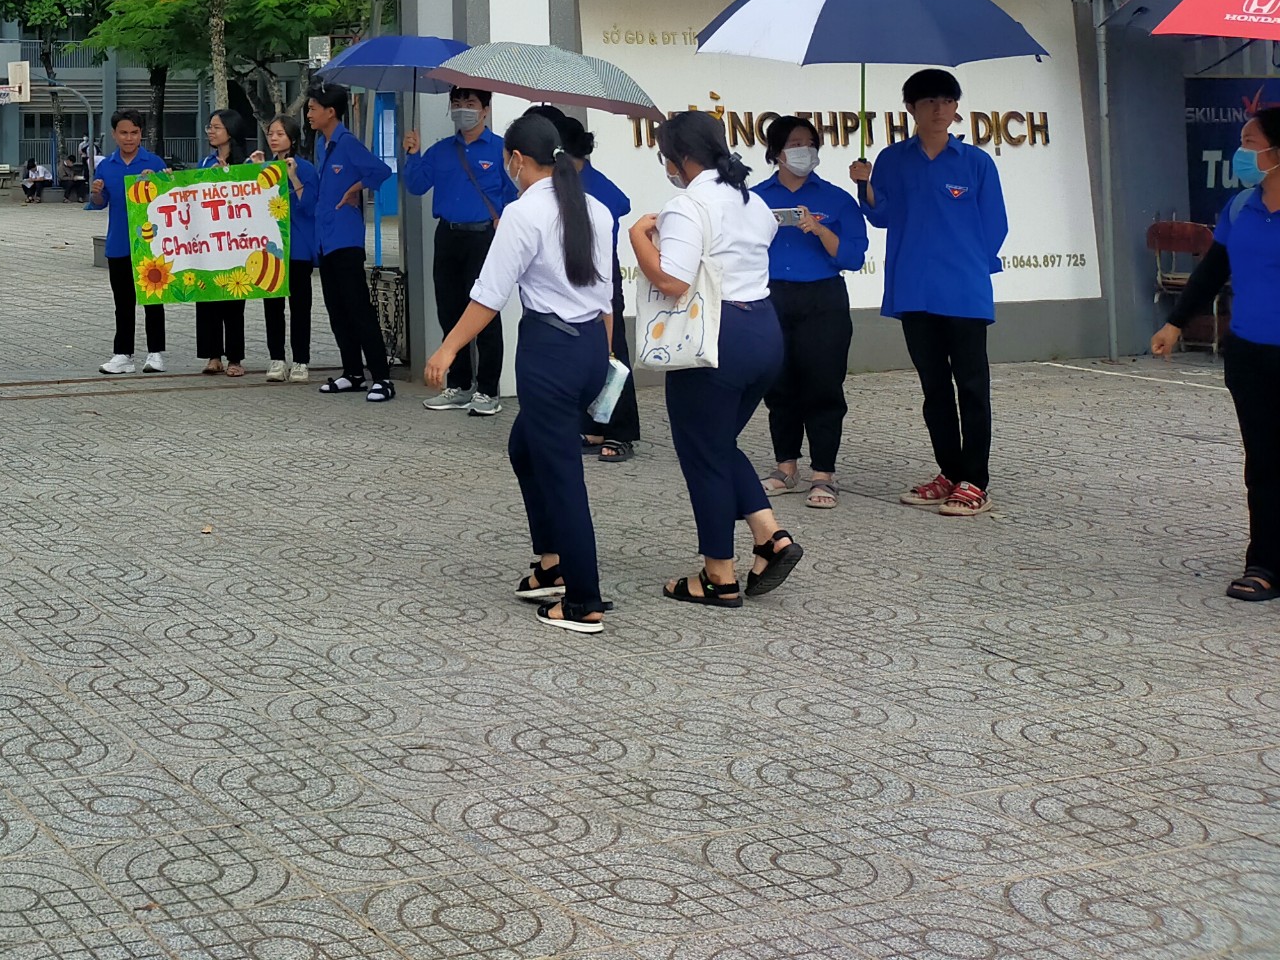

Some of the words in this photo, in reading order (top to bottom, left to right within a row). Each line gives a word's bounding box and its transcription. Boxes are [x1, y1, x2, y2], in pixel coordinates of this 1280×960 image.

[1224, 13, 1280, 24] HONDA
[624, 30, 644, 45] GD
[648, 31, 658, 45] &
[970, 111, 1051, 157] DỊCH
[169, 190, 198, 203] THPT
[231, 182, 261, 200] DỊCH
[157, 203, 190, 230] Tự
[201, 199, 252, 221] Tin
[162, 234, 210, 256] Chiến
[1066, 253, 1086, 267] 725
